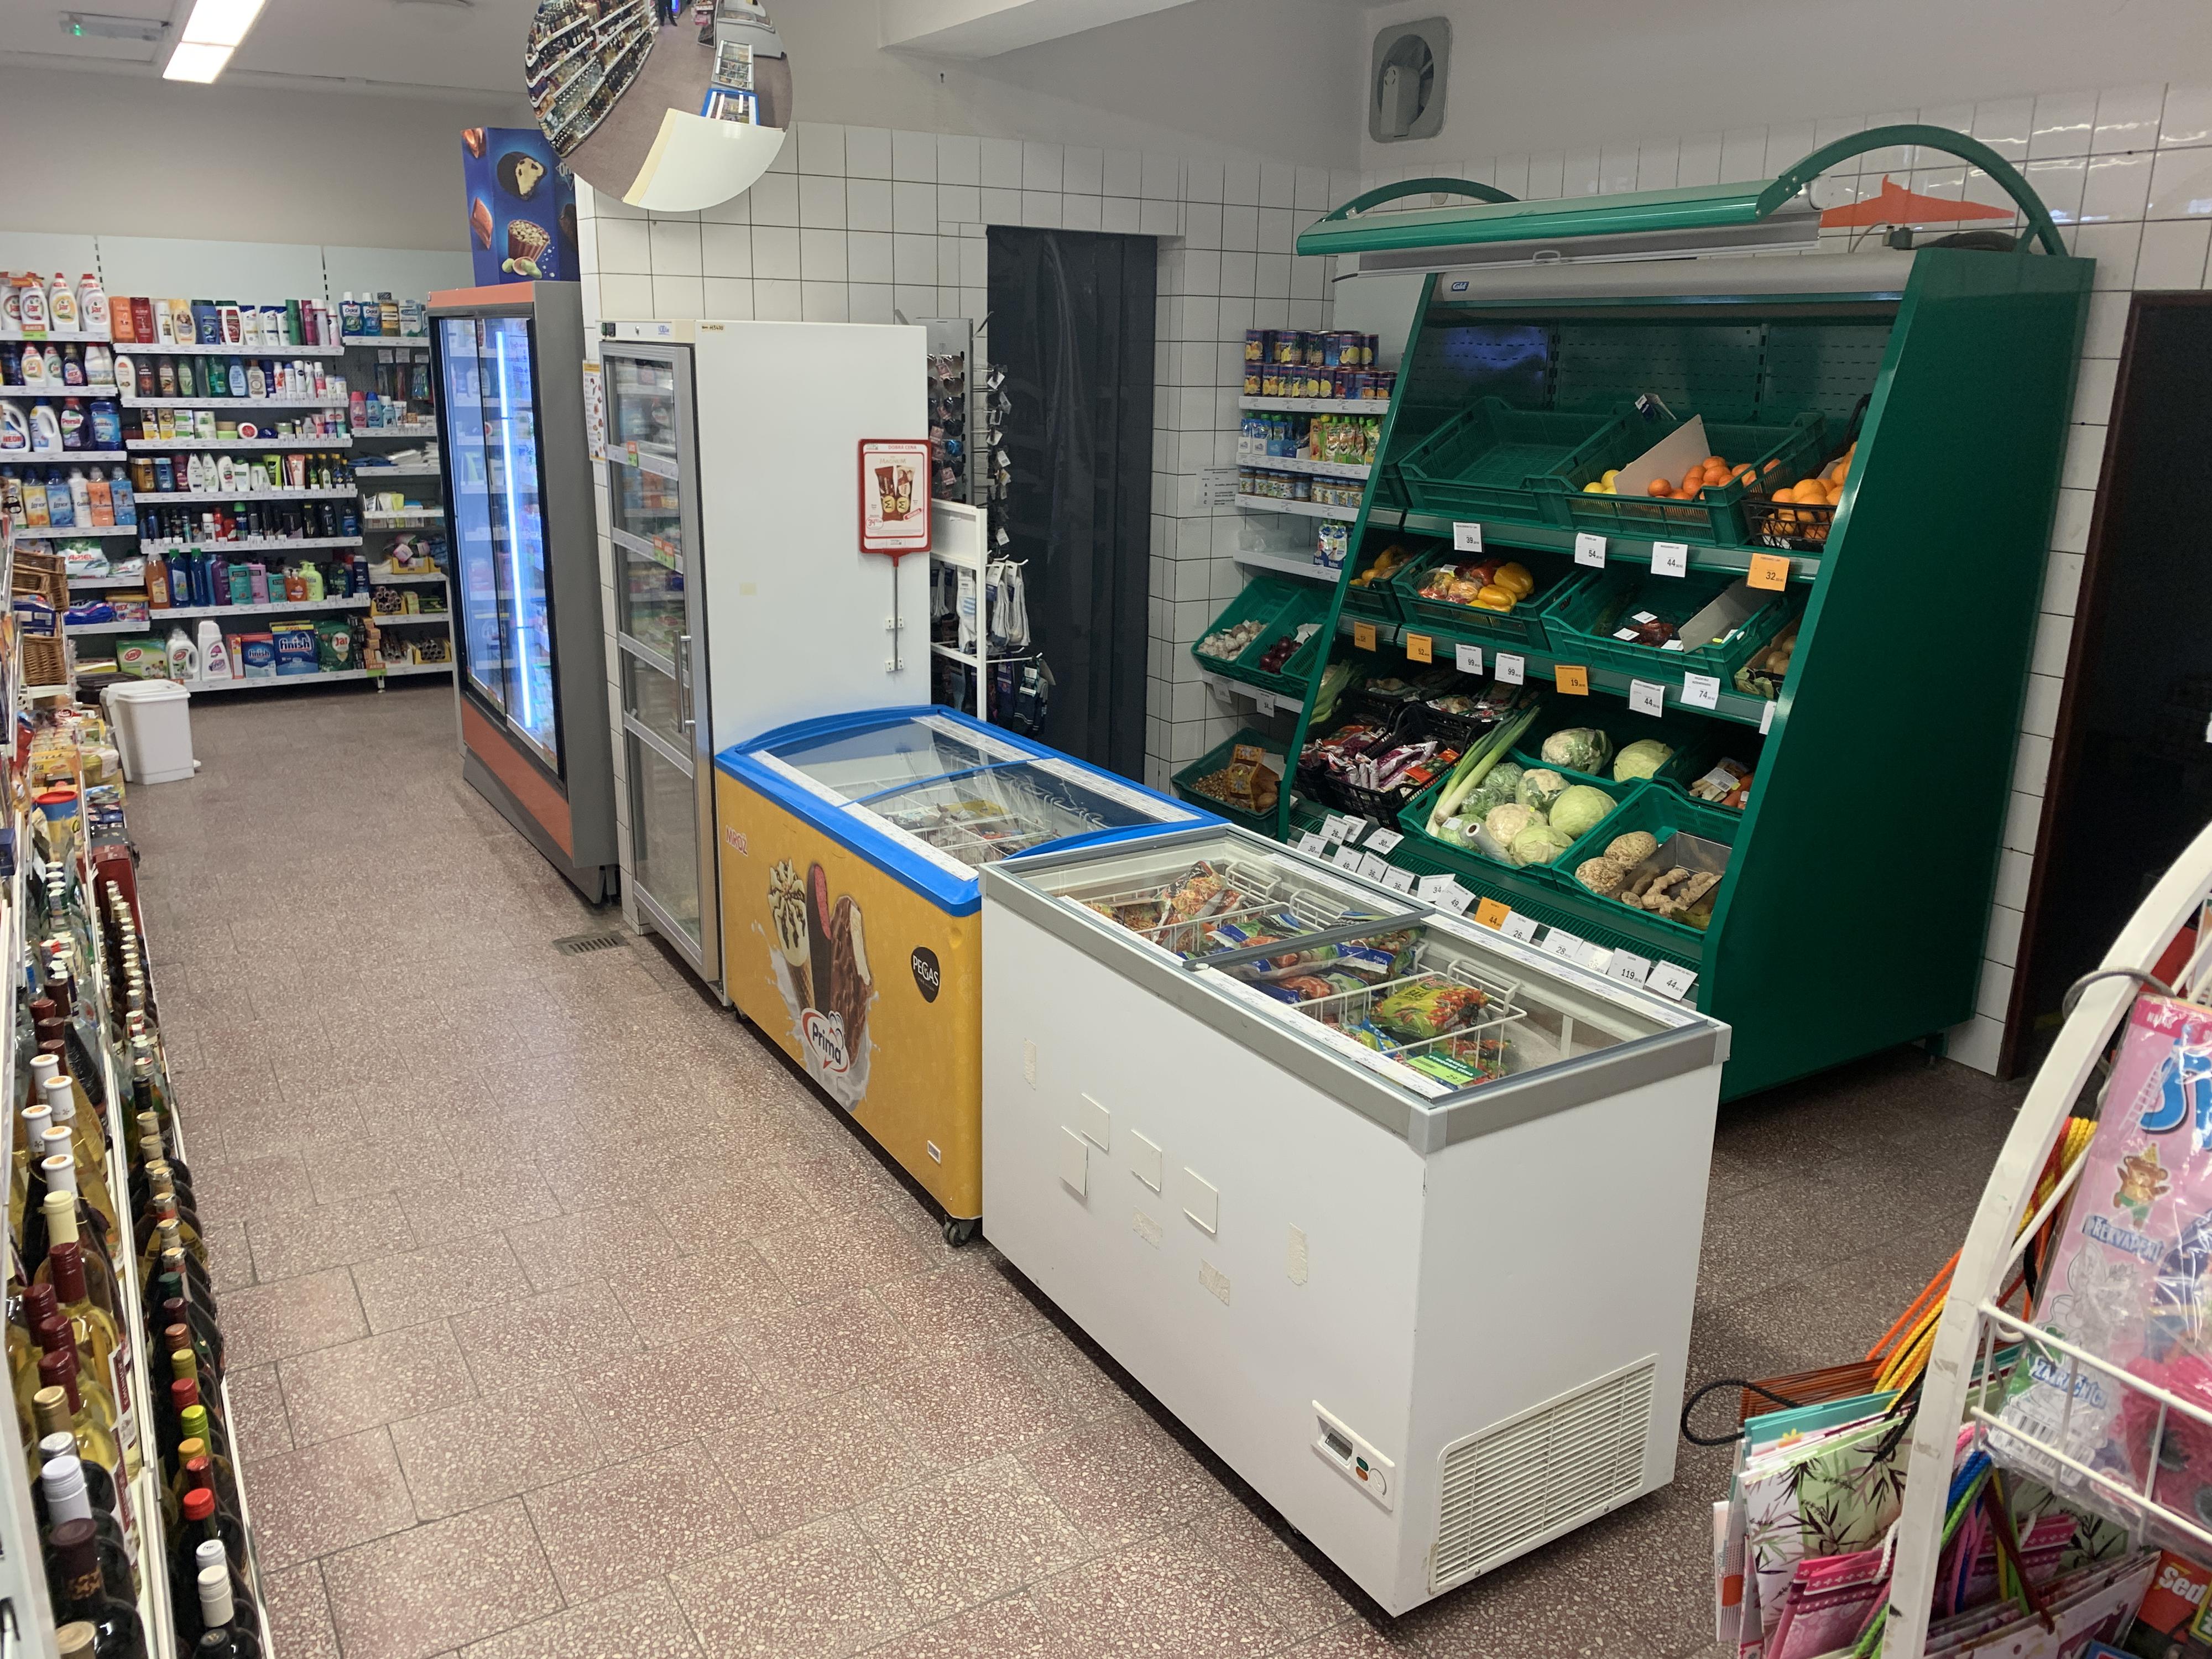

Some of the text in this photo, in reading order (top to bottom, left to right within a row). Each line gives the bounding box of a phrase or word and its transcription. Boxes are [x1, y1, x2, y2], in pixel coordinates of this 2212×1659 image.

[1766, 571, 1776, 580] 32
[280, 637, 310, 650] finish
[249, 648, 270, 658] finish
[1699, 690, 1708, 699] 74
[1644, 697, 1653, 706] 44
[1368, 869, 1376, 878] 36
[1393, 882, 1401, 890] 36
[1489, 916, 1498, 925] 44
[1513, 930, 1522, 939] 26
[1556, 946, 1566, 956] 28
[912, 954, 939, 987] PEGAS
[1621, 968, 1635, 979] 119
[1666, 979, 1677, 988] 44
[812, 1022, 841, 1066] Prima
[2158, 1566, 2208, 1604] Sed
